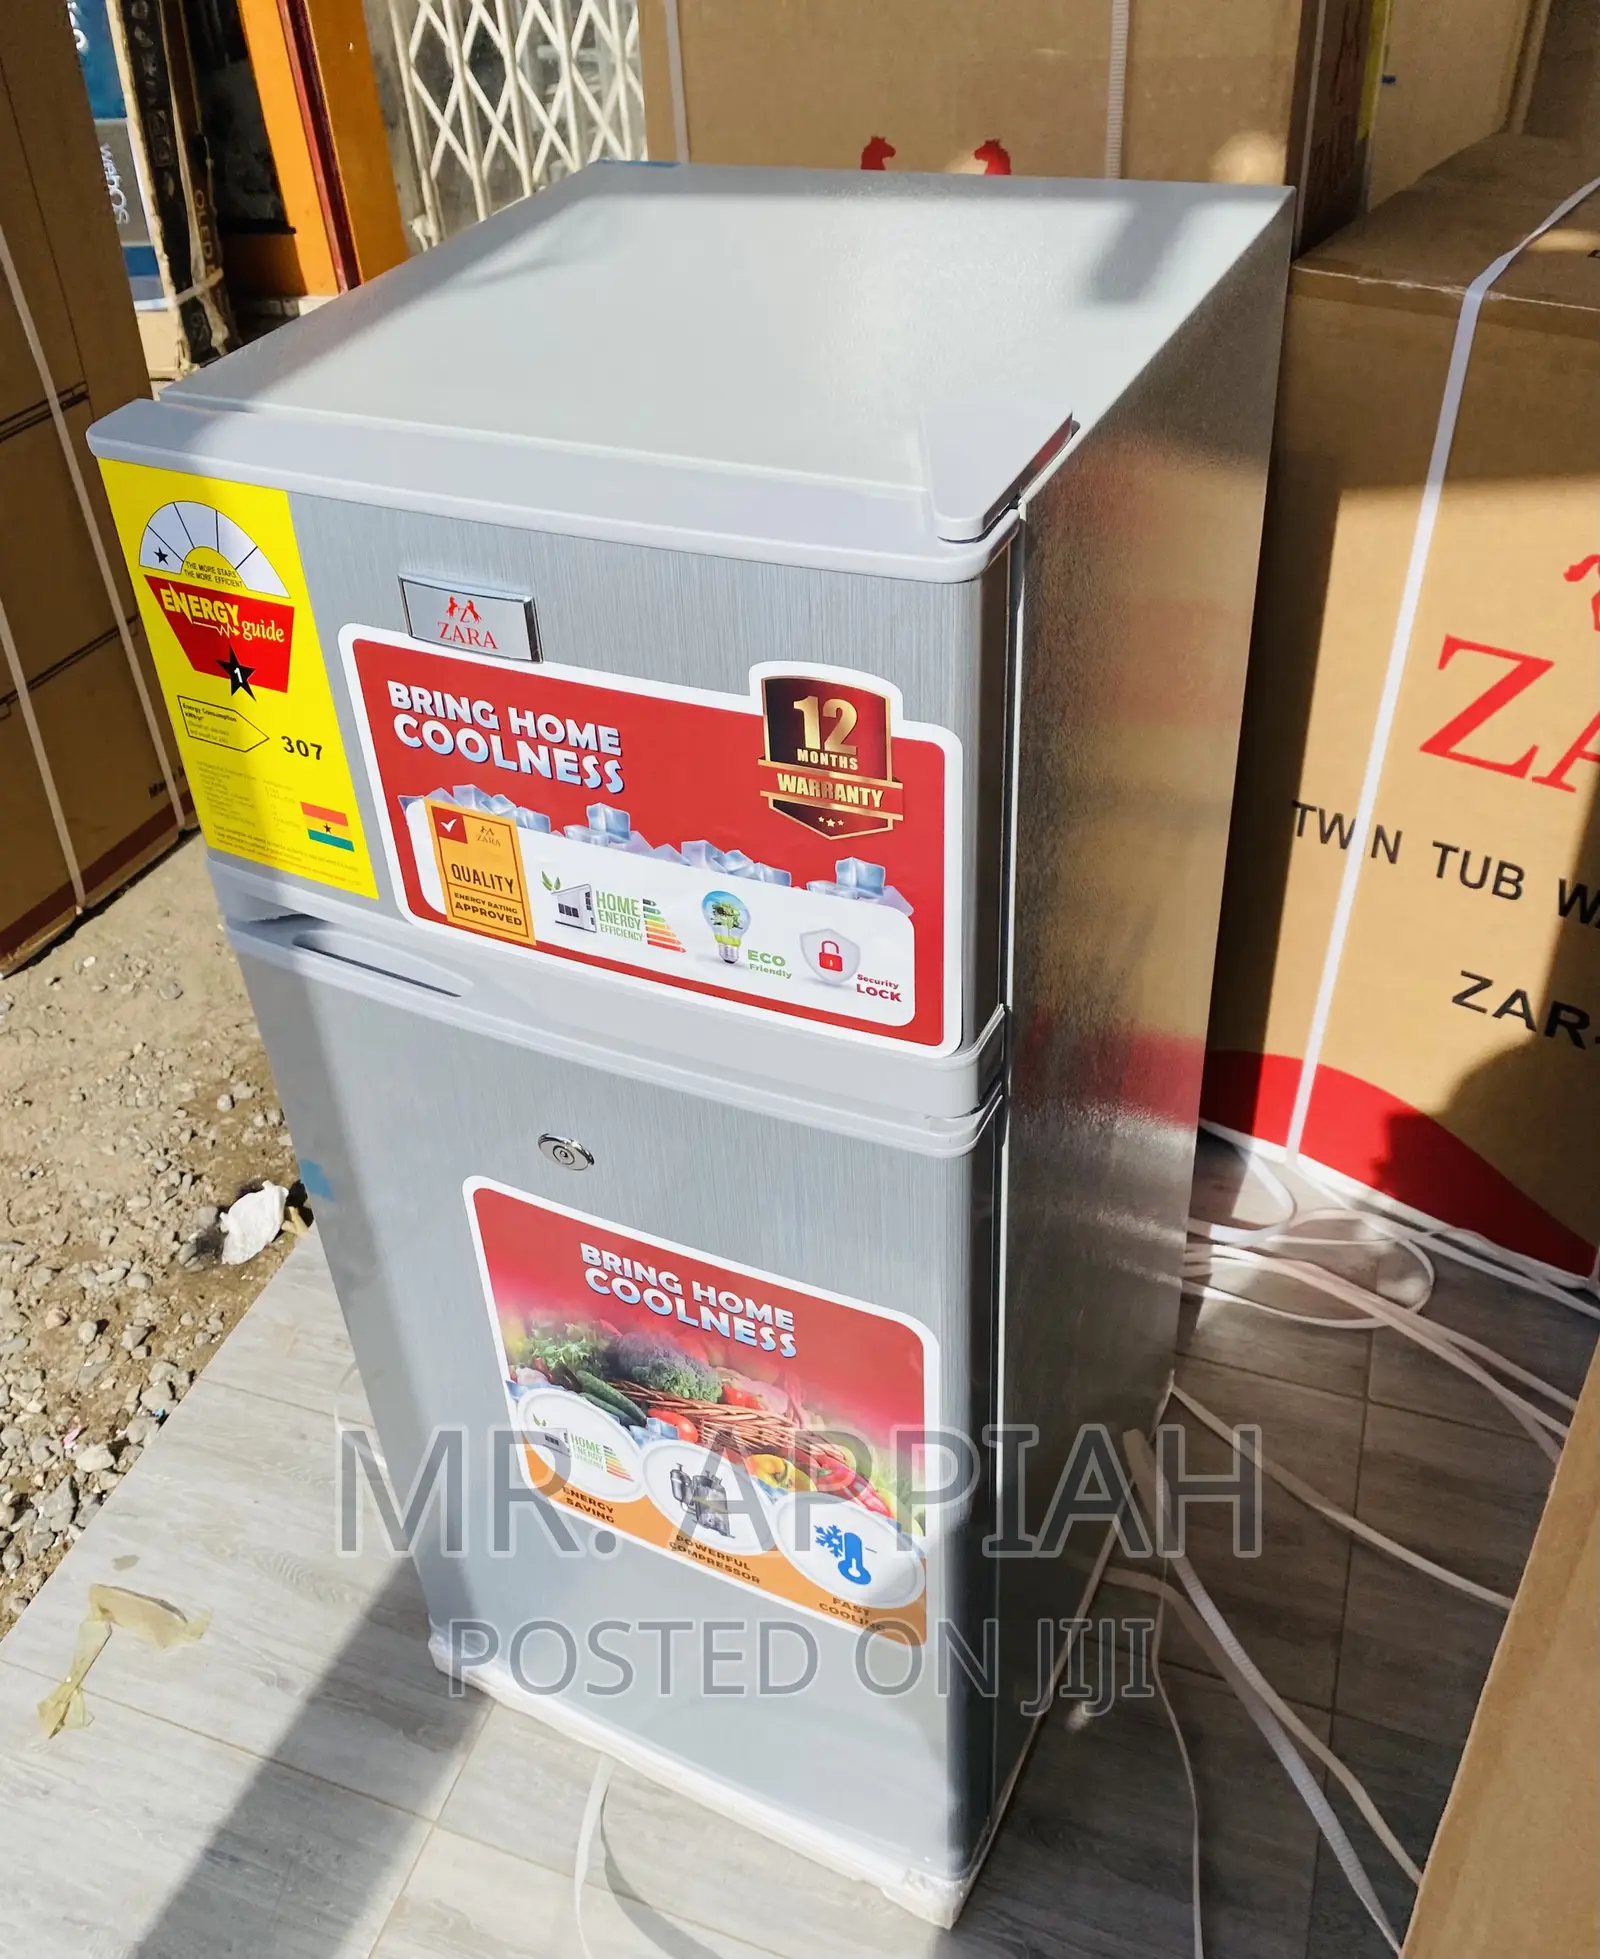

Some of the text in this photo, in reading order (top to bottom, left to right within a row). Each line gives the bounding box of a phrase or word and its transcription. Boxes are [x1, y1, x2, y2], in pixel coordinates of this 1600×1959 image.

[183, 568, 243, 589] THE MORE EFFICIENT
[185, 560, 236, 579] THE MORE STARS
[160, 582, 240, 627] ENERGY
[241, 618, 285, 643] guide
[437, 621, 499, 650] ZARA
[234, 667, 243, 684] 1
[387, 680, 623, 756] BRING HOME
[793, 695, 858, 755] 12
[280, 735, 323, 761] 307
[394, 713, 625, 794] COOLNESS
[797, 748, 859, 771] MONTHS
[777, 772, 884, 808] WARRANTY
[1292, 800, 1600, 929] TWN TUB W
[451, 863, 515, 894] QUALITY
[454, 893, 518, 914] ENERGY RATING
[455, 902, 523, 926] APPROVED
[596, 891, 641, 918] HOME
[599, 911, 642, 931] ENERGY
[600, 923, 645, 942] EFFICIENCY
[747, 949, 786, 967] ECO
[749, 963, 793, 980] Friendly
[857, 973, 900, 990] Security
[856, 983, 902, 1002] LOCK
[580, 1241, 796, 1333] BRING HOME
[584, 1267, 798, 1359] COOLNESS
[570, 1434, 602, 1452] HOME
[563, 1486, 614, 1514] ENERGY
[566, 1497, 615, 1523] SAVING
[669, 1541, 760, 1584] COMPRESSOR
[676, 1534, 751, 1571] POWERFUL
[819, 1602, 886, 1633] COOLING
[832, 1596, 871, 1617] FAST
